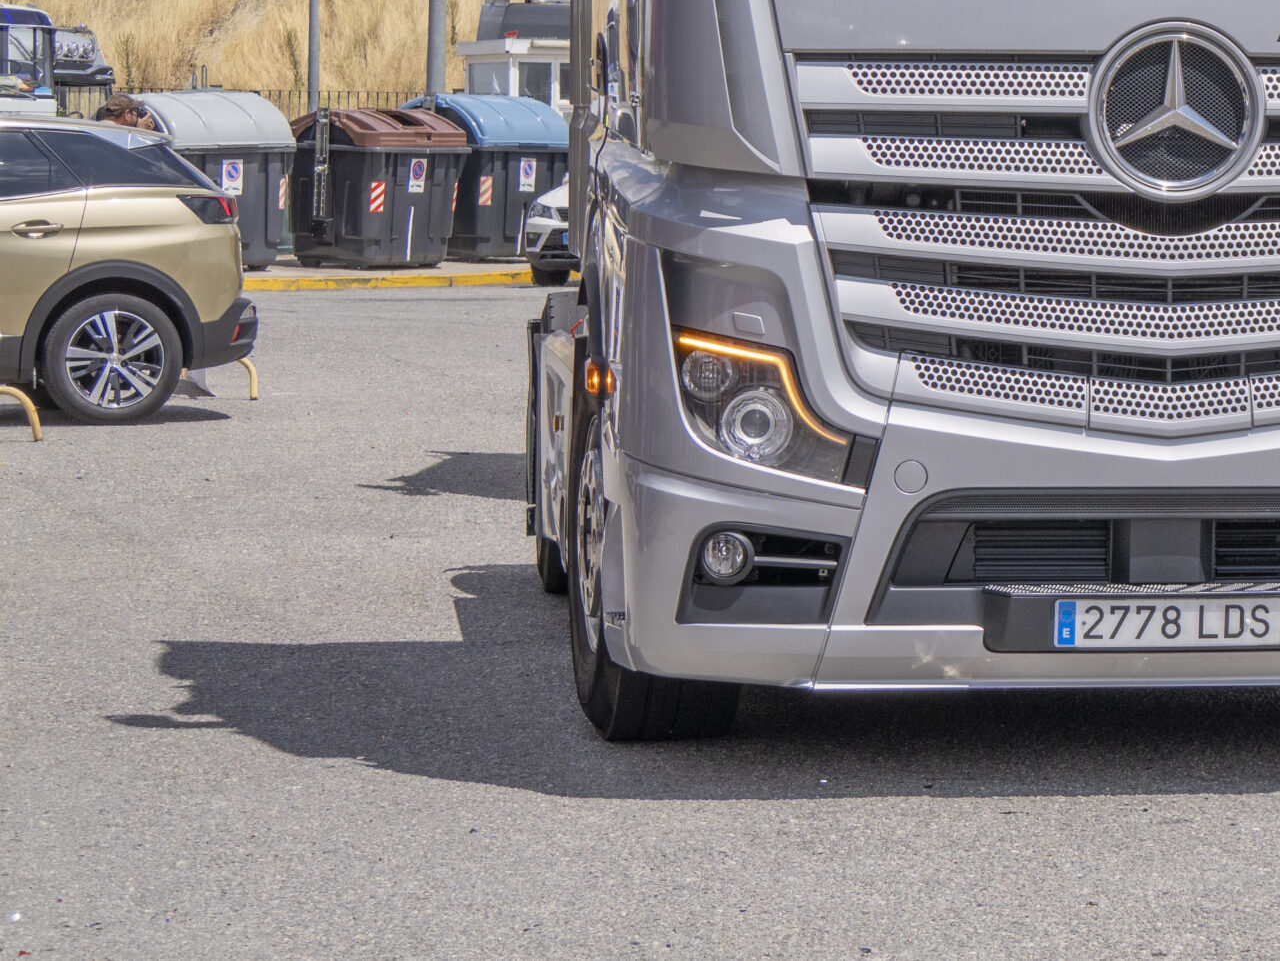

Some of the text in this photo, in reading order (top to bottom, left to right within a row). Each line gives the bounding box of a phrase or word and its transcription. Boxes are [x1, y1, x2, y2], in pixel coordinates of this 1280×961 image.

[1062, 628, 1071, 638] E
[1082, 604, 1271, 640] 2778 LDS
